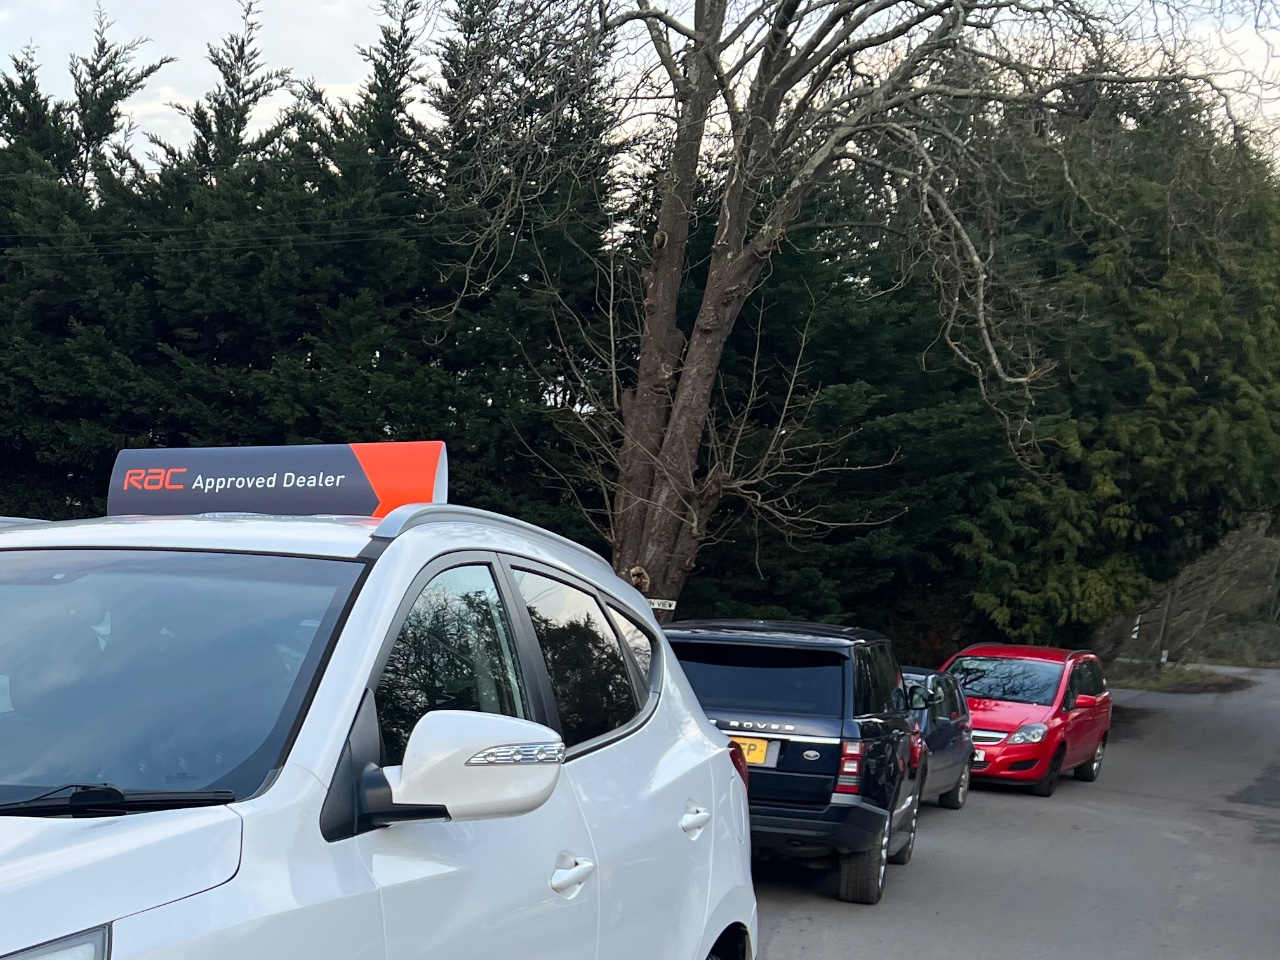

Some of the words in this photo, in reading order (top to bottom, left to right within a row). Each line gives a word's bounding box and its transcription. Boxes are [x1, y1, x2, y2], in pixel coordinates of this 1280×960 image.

[192, 472, 277, 493] Approved
[283, 472, 345, 488] Dealer
[729, 720, 795, 731] ROVER
